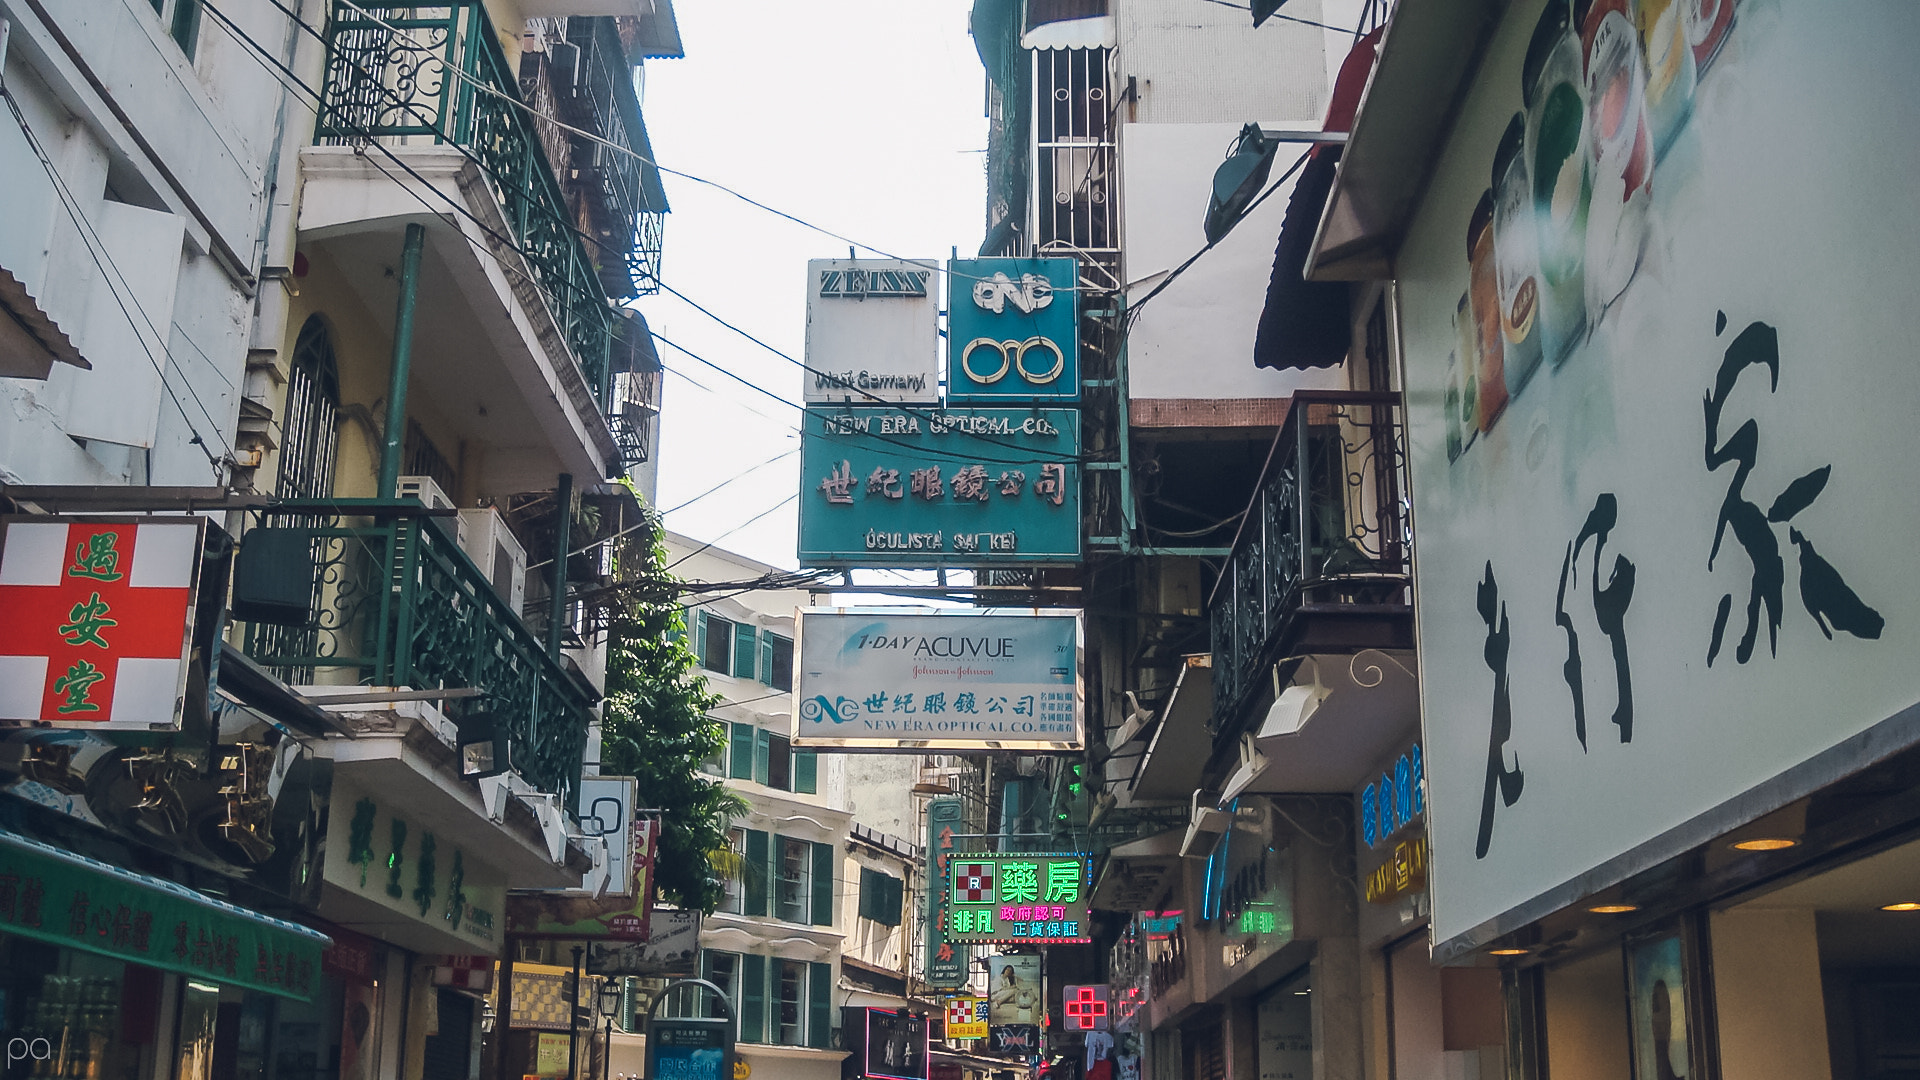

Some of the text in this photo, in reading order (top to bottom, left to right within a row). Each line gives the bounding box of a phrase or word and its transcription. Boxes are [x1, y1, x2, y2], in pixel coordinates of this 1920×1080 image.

[815, 369, 926, 393] West Germany
[824, 412, 1059, 437] NEW ERA OPTICAL CO.
[816, 459, 1066, 505] 世紀眼鏡公司
[865, 528, 943, 550] OCULISTA
[914, 637, 1015, 658] ACUVUE
[912, 665, 949, 679] Johnson
[956, 666, 993, 679] Johnson
[862, 691, 1035, 717] 世紀眼鏡公司
[864, 720, 1037, 733] NEW ERA OPTICAL CO.
[1001, 860, 1080, 903] 藥房
[953, 909, 995, 933] 非凡
[1000, 906, 1067, 921] 政府認可
